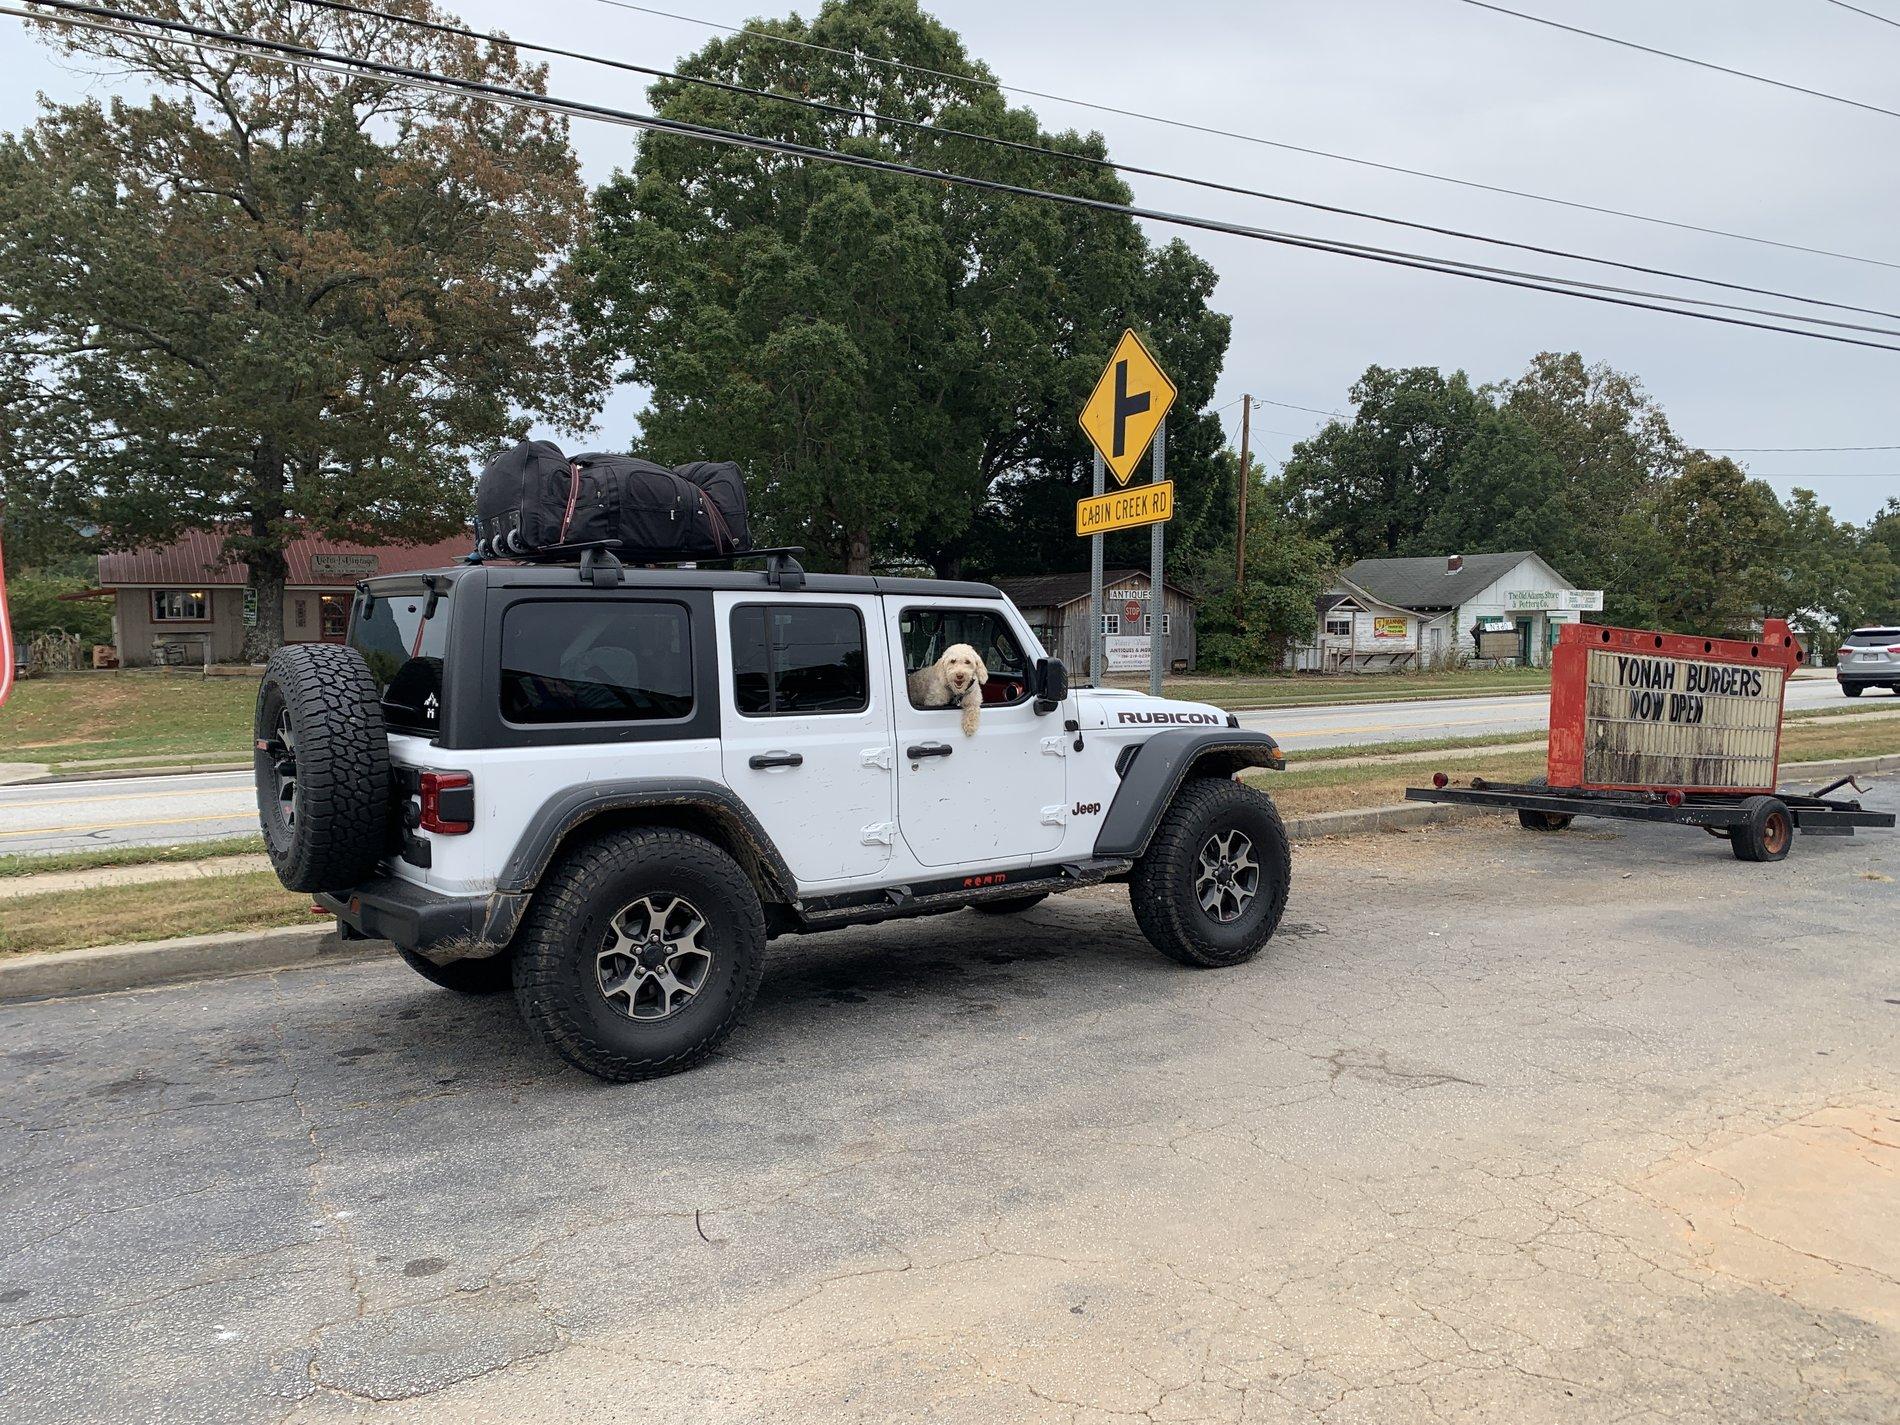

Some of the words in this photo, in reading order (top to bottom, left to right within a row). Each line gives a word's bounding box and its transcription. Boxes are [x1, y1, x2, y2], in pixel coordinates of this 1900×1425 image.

[1081, 502, 1111, 526] CABIN
[1115, 494, 1148, 520] CREEK
[1152, 491, 1167, 514] RD
[1508, 592, 1518, 600] The
[1544, 590, 1559, 599] Store
[1125, 606, 1140, 616] STOP
[1618, 656, 1675, 689] YONAH
[1686, 664, 1762, 697] BURGERS
[1630, 690, 1664, 721] NOW
[1669, 693, 1704, 724] OPEN
[1117, 712, 1219, 725] RUBICON
[1072, 802, 1101, 816] Jeep
